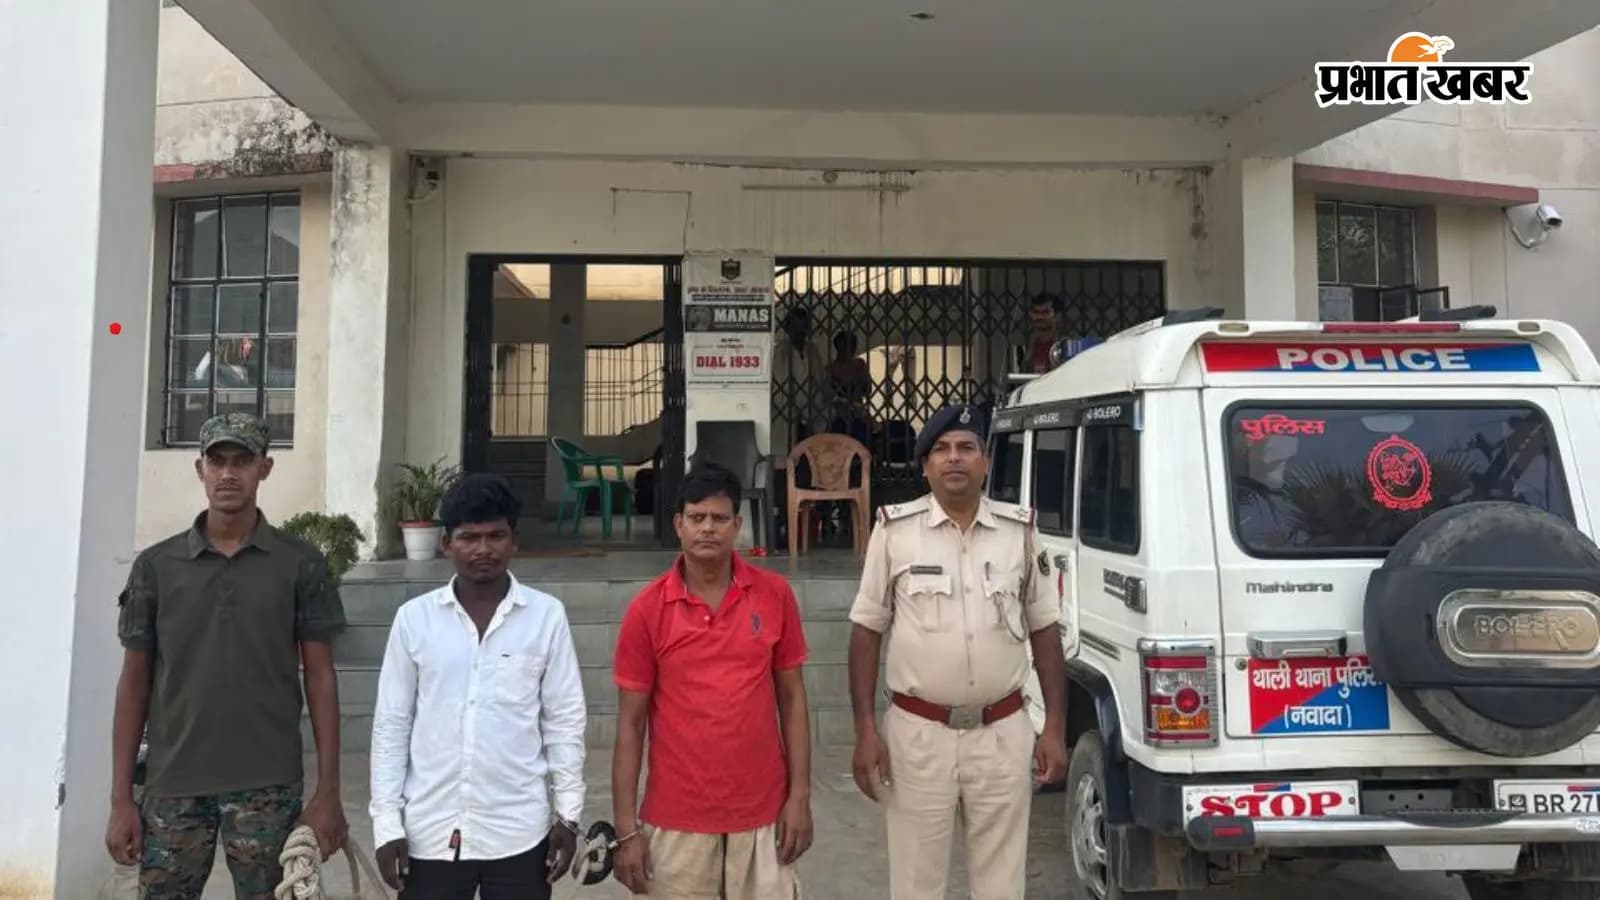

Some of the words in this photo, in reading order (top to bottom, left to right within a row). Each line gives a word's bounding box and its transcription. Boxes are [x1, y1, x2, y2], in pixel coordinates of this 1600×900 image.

[714, 308, 769, 322] MANAS
[696, 356, 726, 369] DIAL
[730, 356, 760, 368] 1933
[1276, 347, 1471, 371] POLICE
[1240, 413, 1327, 441] पुलिस
[1246, 581, 1334, 594] Mahindra
[1474, 613, 1581, 650] BOLERO
[1252, 660, 1292, 690] थाली
[1295, 667, 1332, 688] थाना
[1201, 791, 1343, 818] STOP
[1534, 794, 1564, 812] BR
